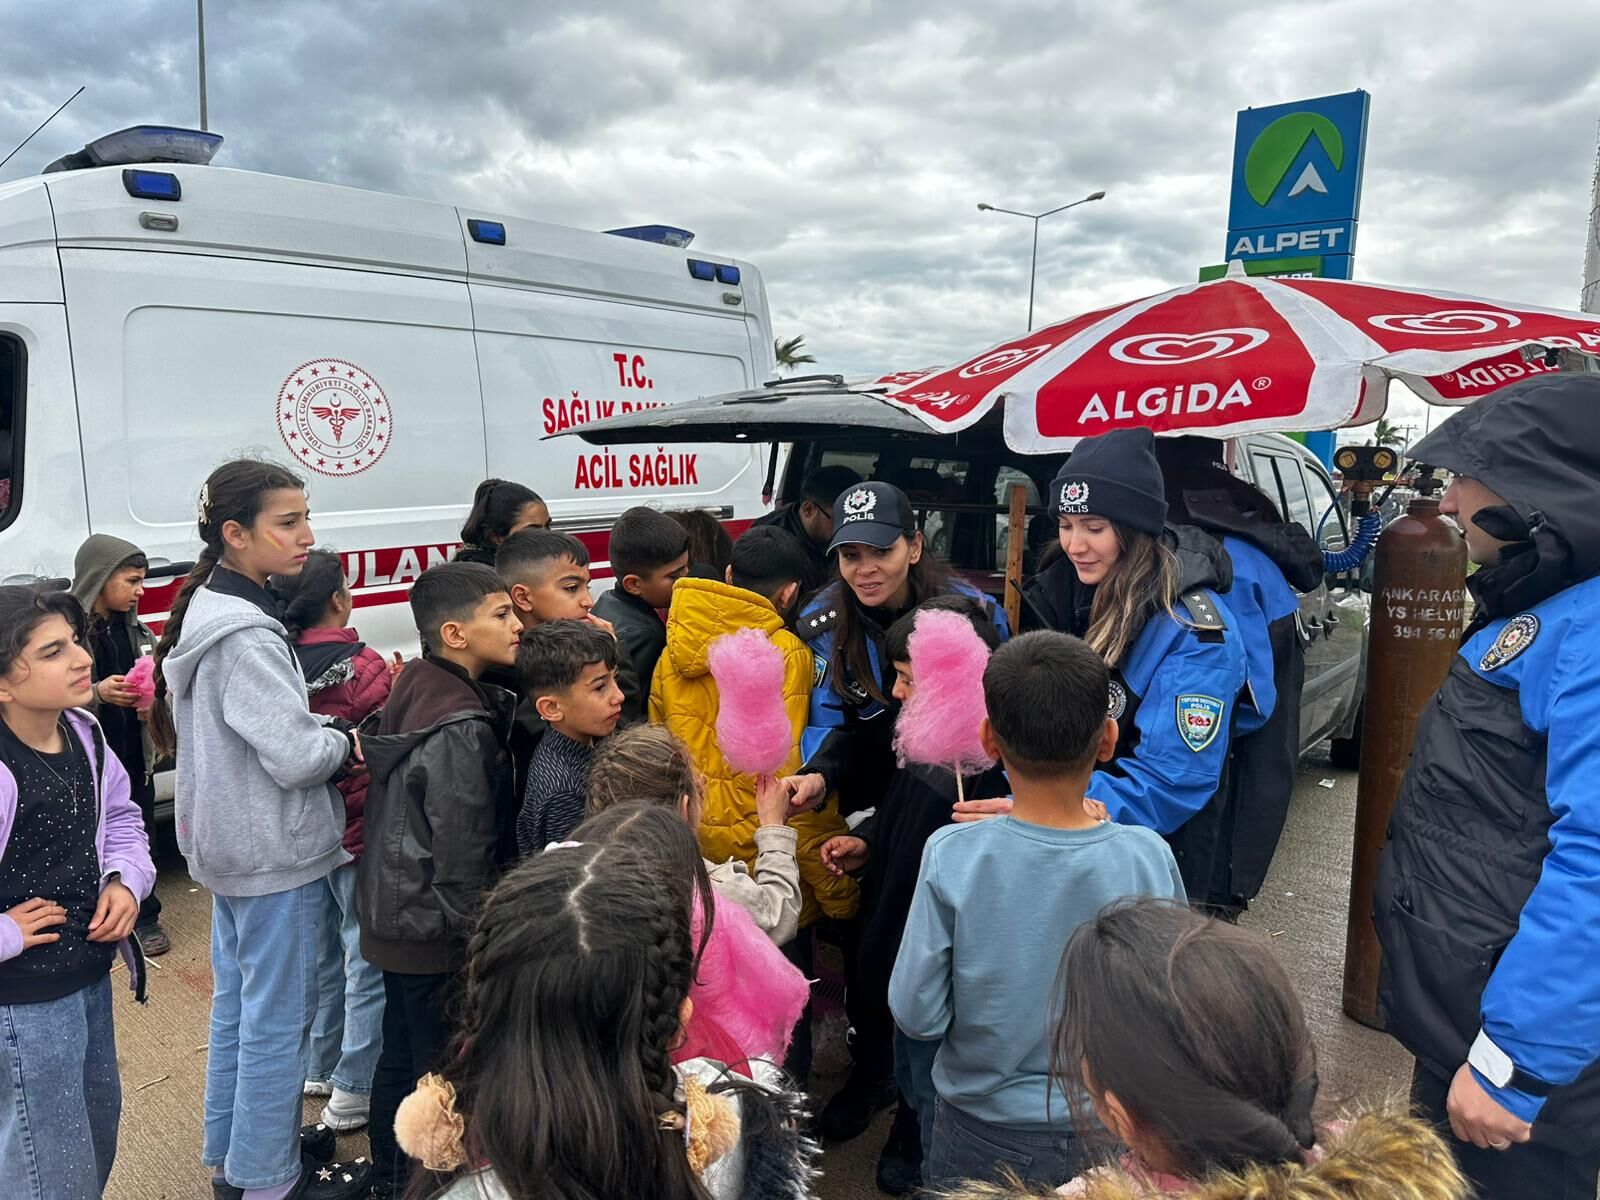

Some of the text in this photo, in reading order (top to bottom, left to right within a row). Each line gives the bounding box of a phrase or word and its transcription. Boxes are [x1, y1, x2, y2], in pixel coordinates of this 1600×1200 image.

[1231, 227, 1345, 256] ALPET
[613, 352, 654, 389] T.C.
[299, 379, 342, 414] CUMHURİYETİ
[344, 383, 368, 406] SAĞLIK
[355, 407, 374, 450] BAKANLIĞI
[574, 446, 698, 489] ACİL SAĞLIK
[843, 511, 875, 525] POLİS
[1387, 605, 1464, 621] YS HELYU
